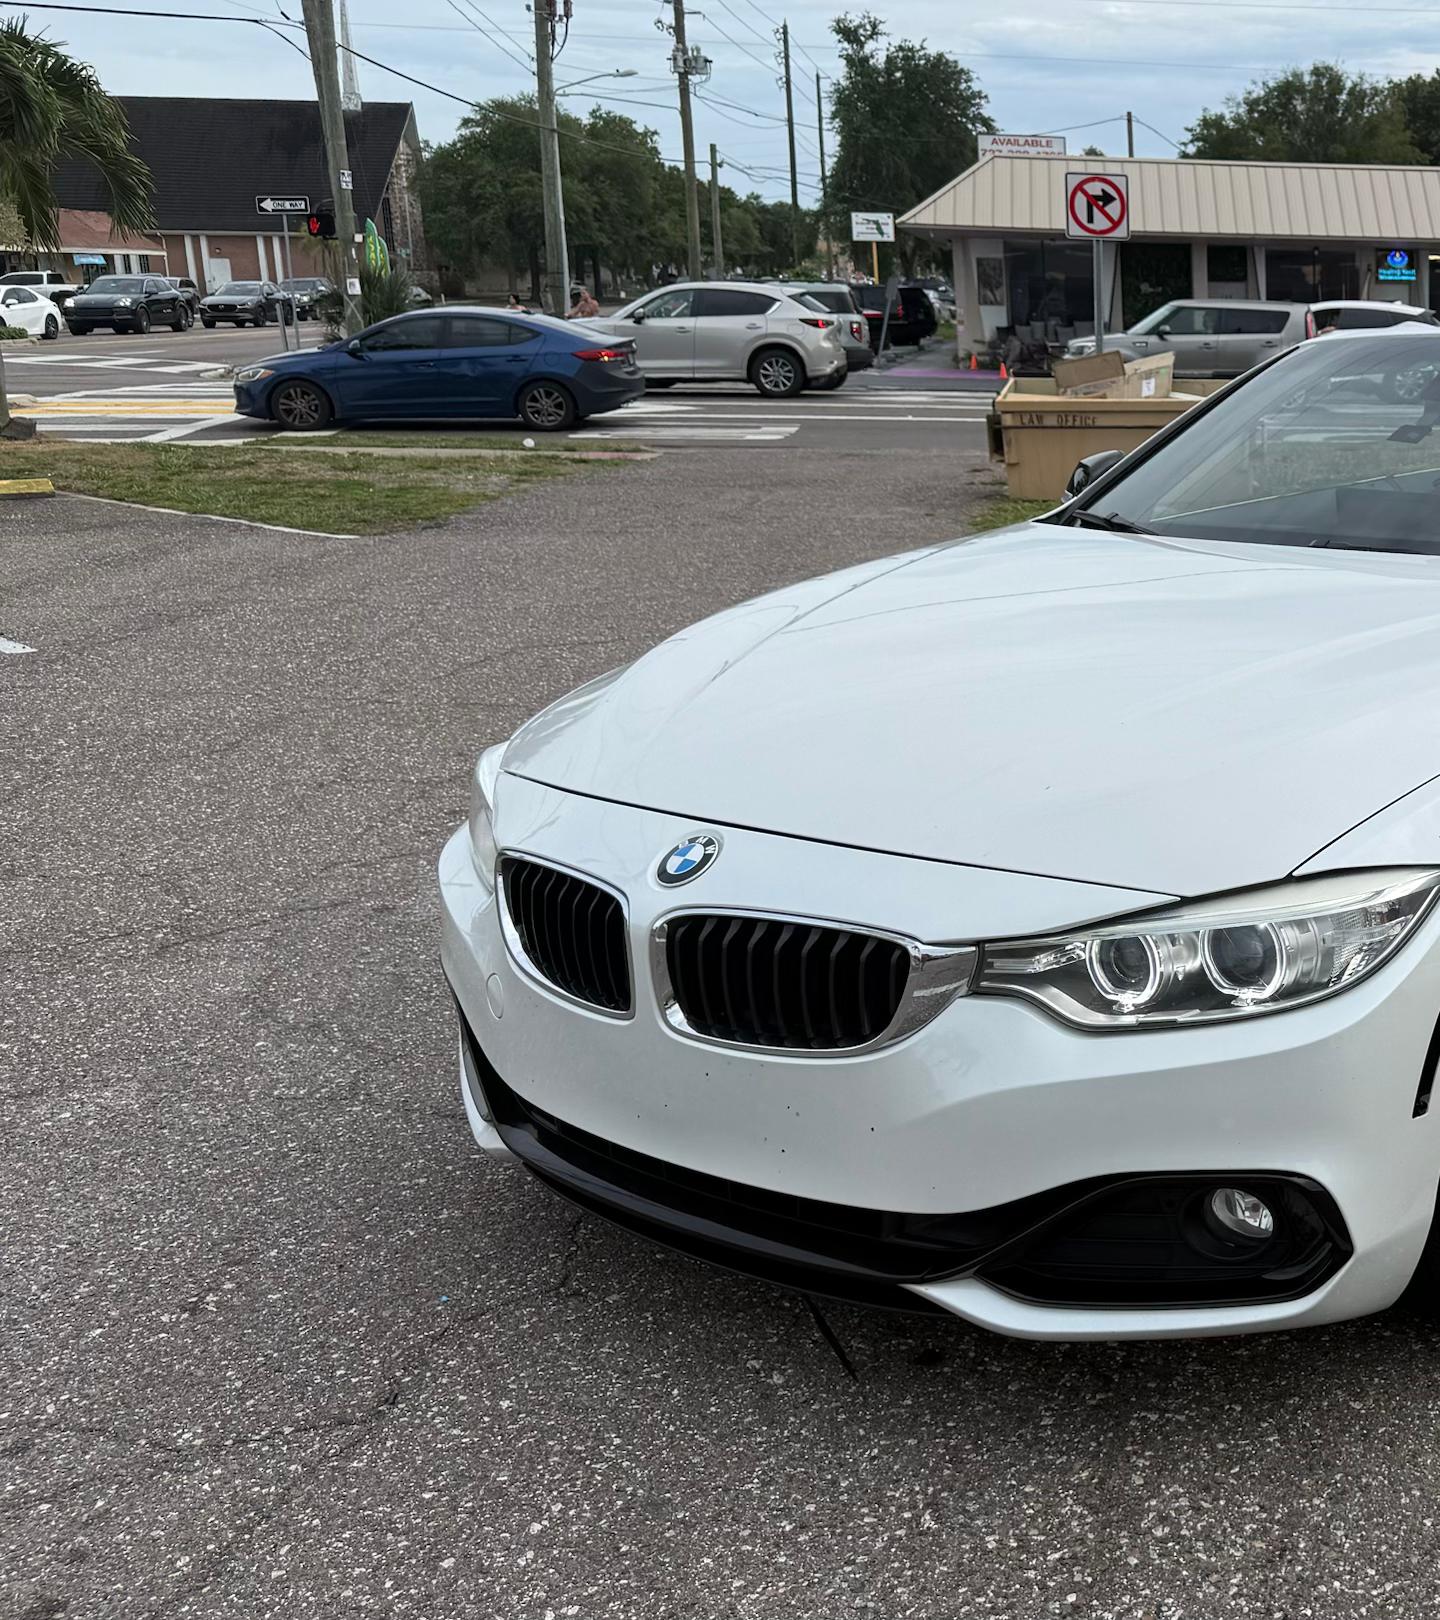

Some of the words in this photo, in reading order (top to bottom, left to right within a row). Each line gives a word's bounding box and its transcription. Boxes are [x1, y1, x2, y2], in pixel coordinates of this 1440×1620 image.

[991, 137, 1053, 148] AVAILABLE
[272, 200, 286, 208] ONE
[289, 200, 303, 208] WAY
[1019, 414, 1044, 425] LAW
[1057, 414, 1097, 427] OFFICE
